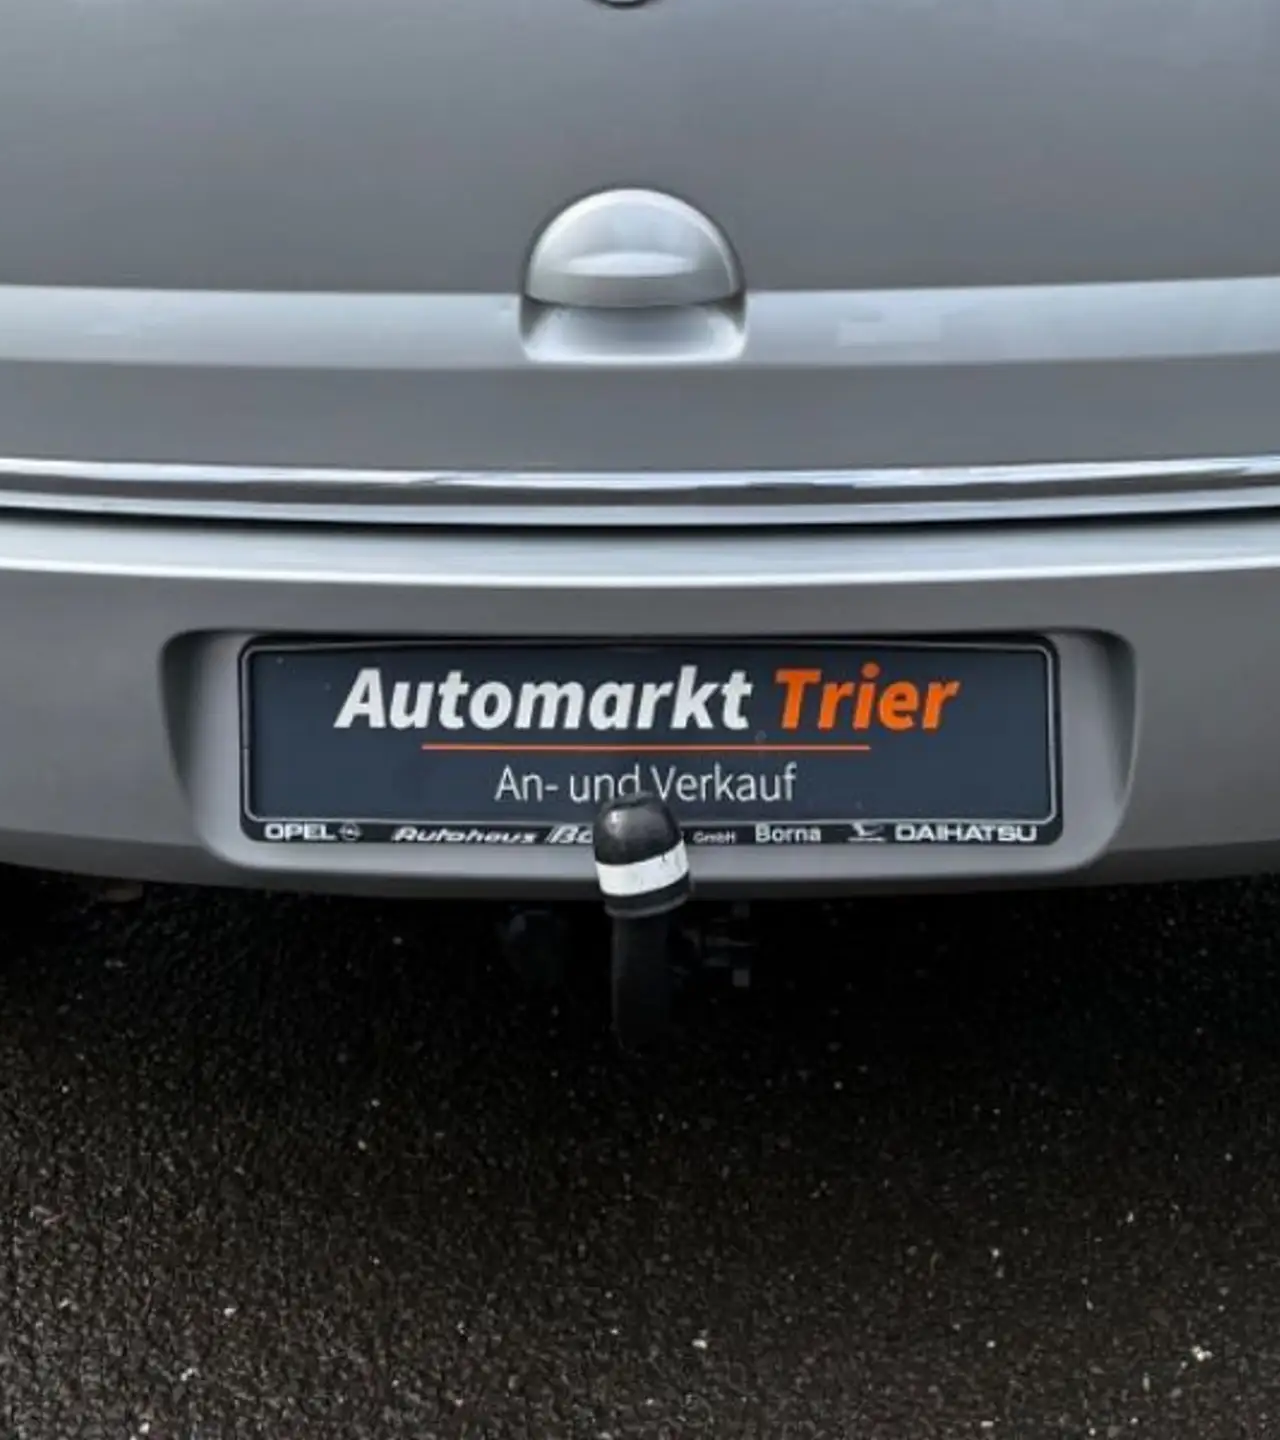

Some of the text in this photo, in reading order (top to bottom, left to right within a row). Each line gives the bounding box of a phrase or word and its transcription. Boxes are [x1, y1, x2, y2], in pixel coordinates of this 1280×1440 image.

[333, 664, 960, 731] Automarkt Trier
[494, 762, 798, 803] An- und Verkauf
[264, 823, 336, 840] OPEL
[391, 826, 537, 844] Autohaus
[692, 831, 736, 845] GmbH
[754, 824, 822, 843] Borna
[895, 824, 1038, 842] DAIHATSU
